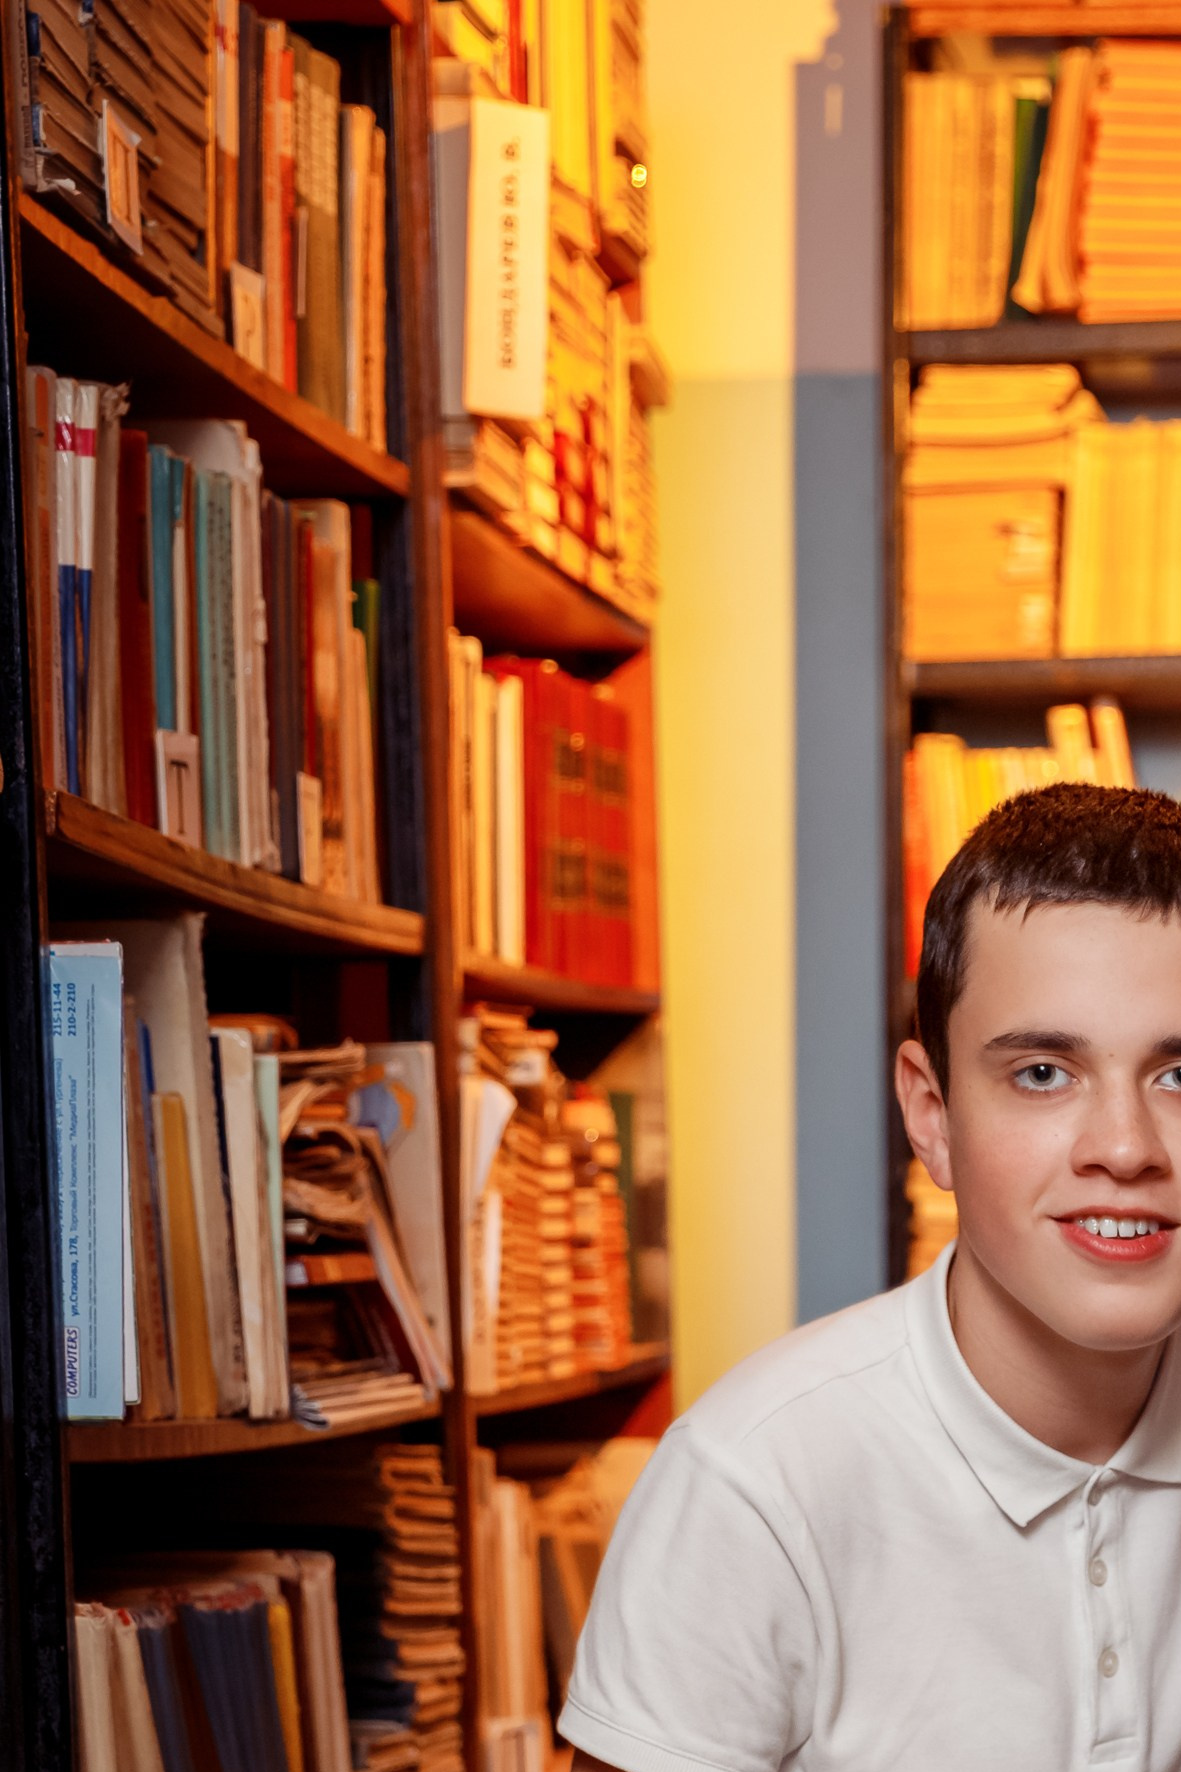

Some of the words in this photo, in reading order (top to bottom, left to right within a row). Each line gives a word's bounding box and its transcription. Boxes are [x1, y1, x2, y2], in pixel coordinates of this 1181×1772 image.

[67, 982, 77, 1037] 210-2-210
[70, 1144, 78, 1188] Комплекс
[65, 1328, 79, 1396] COMPUTERS
